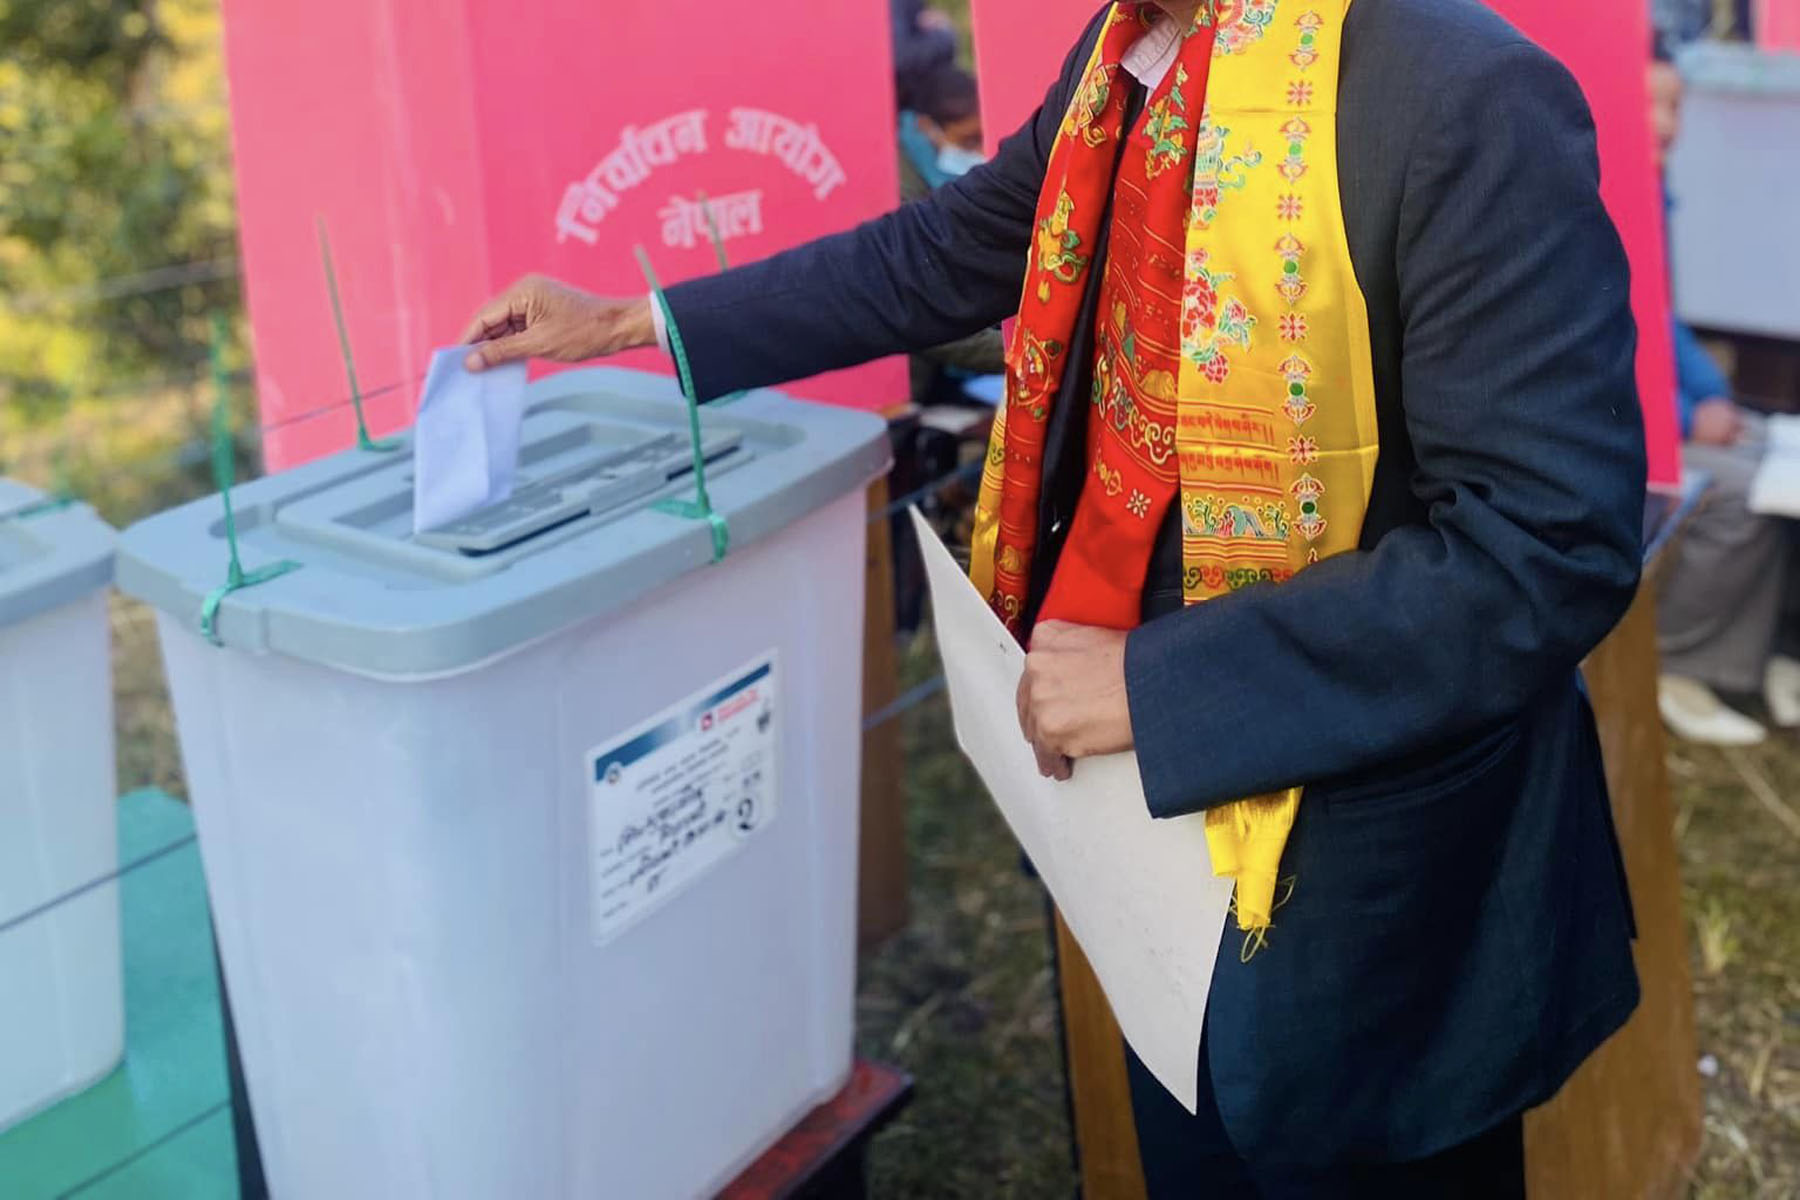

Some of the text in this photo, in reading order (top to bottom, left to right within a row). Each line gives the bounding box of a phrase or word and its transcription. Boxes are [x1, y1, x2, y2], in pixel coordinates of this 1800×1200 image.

[556, 106, 847, 245] निर्वाचन आयोग
[656, 189, 764, 248] नेपाल
